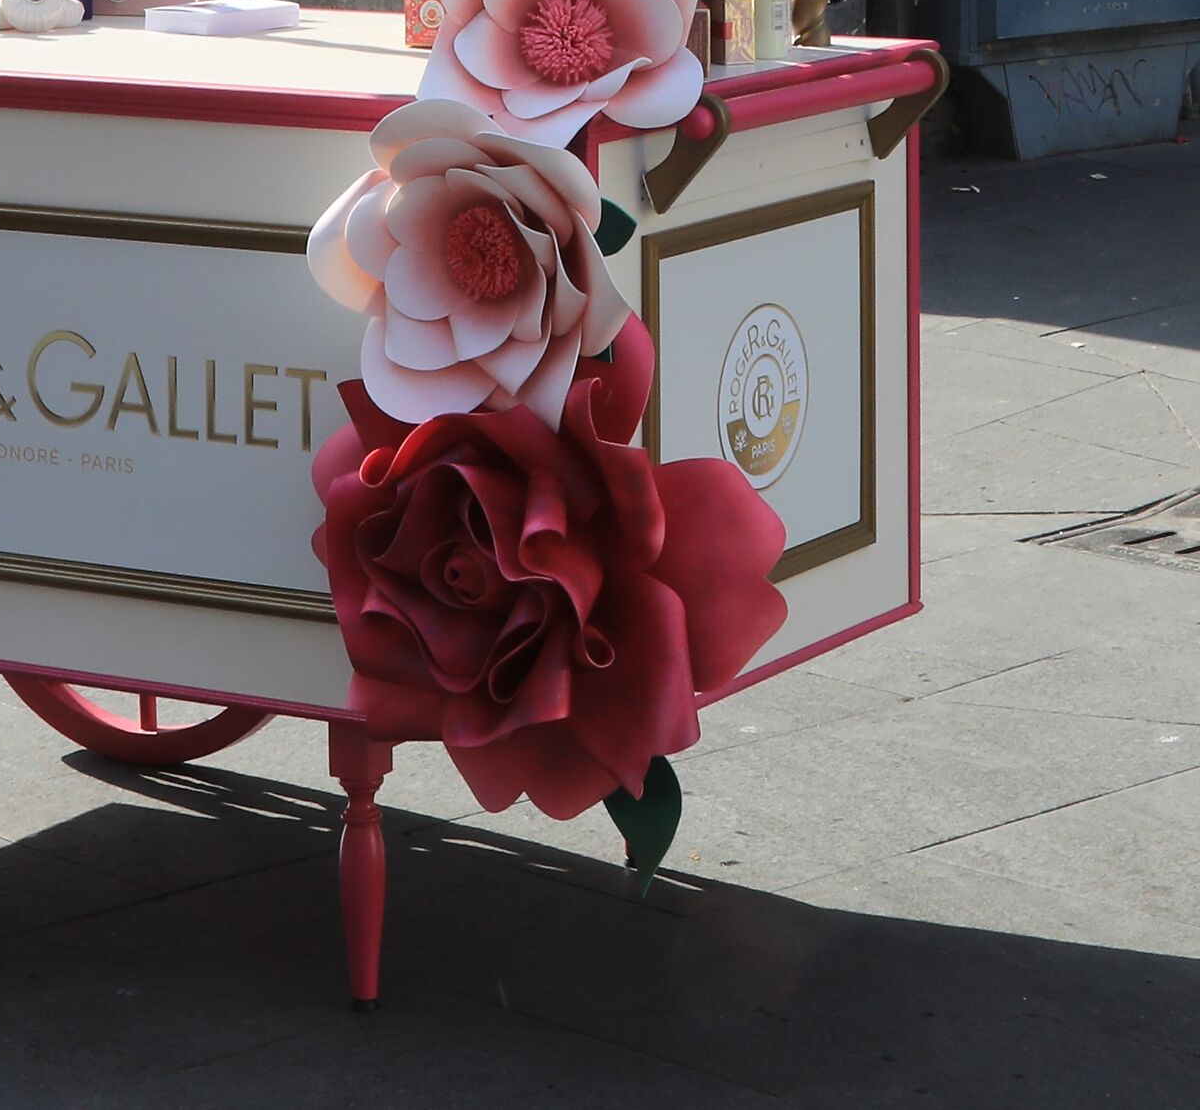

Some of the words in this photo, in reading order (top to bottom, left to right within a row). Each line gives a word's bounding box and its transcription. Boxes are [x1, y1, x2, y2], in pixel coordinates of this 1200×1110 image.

[27, 329, 328, 452] GALLET
[729, 324, 761, 413] ROGER
[766, 319, 798, 396] GALLET
[82, 453, 134, 474] PARIS
[751, 440, 776, 459] PARIS
